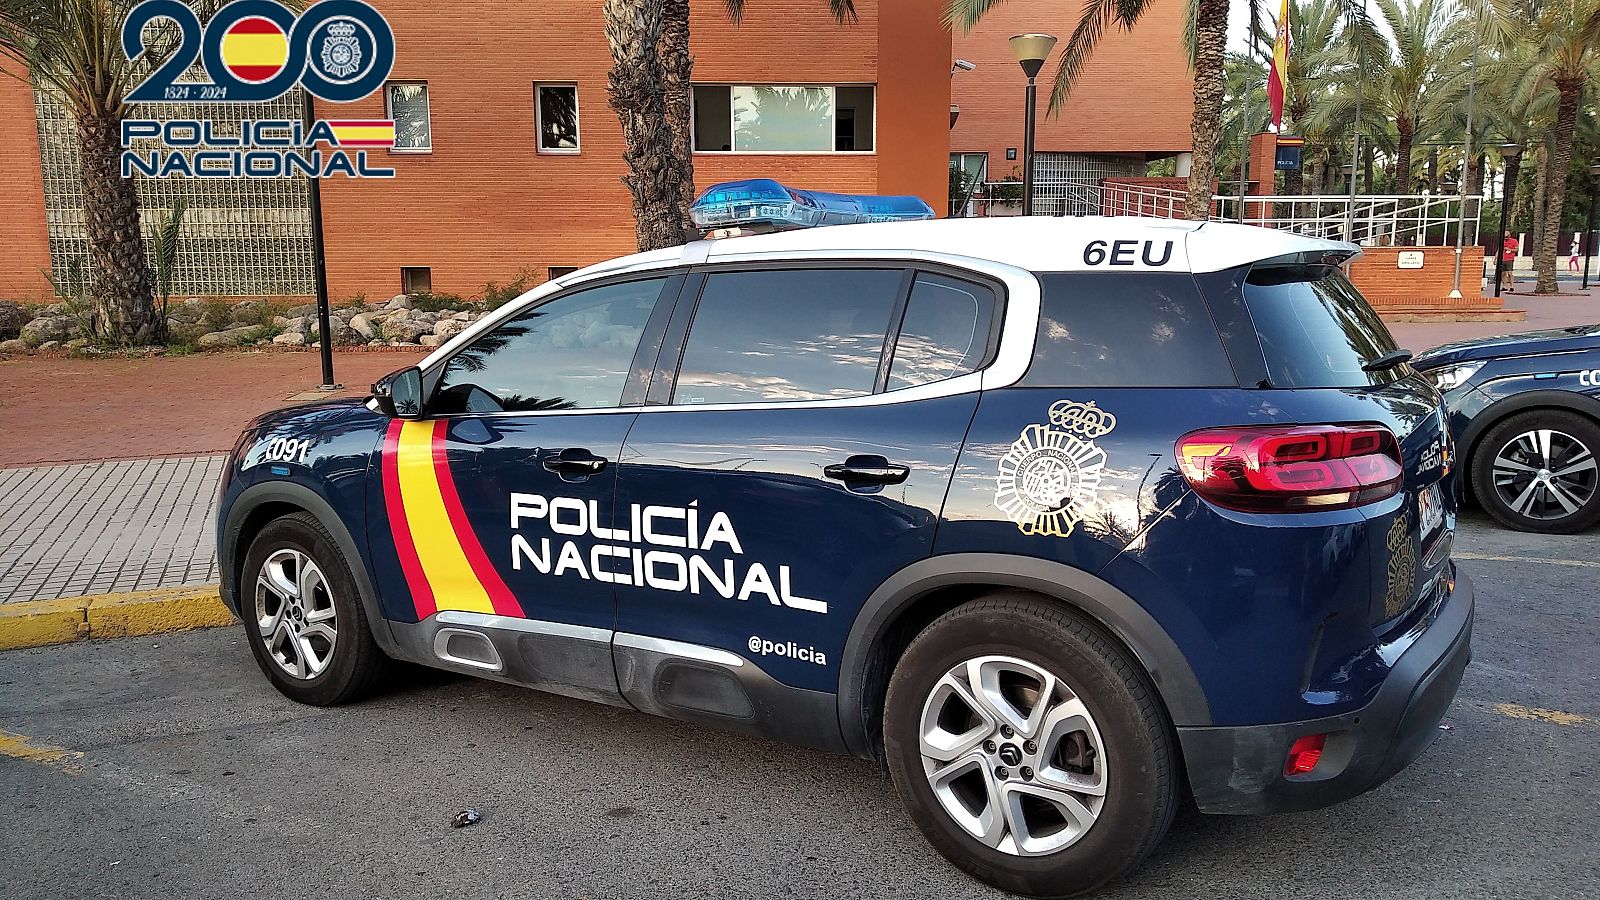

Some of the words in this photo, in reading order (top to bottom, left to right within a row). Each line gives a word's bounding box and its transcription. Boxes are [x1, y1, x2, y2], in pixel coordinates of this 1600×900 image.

[1083, 240, 1174, 266] 6EU
[1017, 451, 1042, 477] CUERPO
[510, 492, 744, 554] POLICÍA
[511, 534, 828, 614] NACIONAL
[748, 635, 827, 666] @policia
